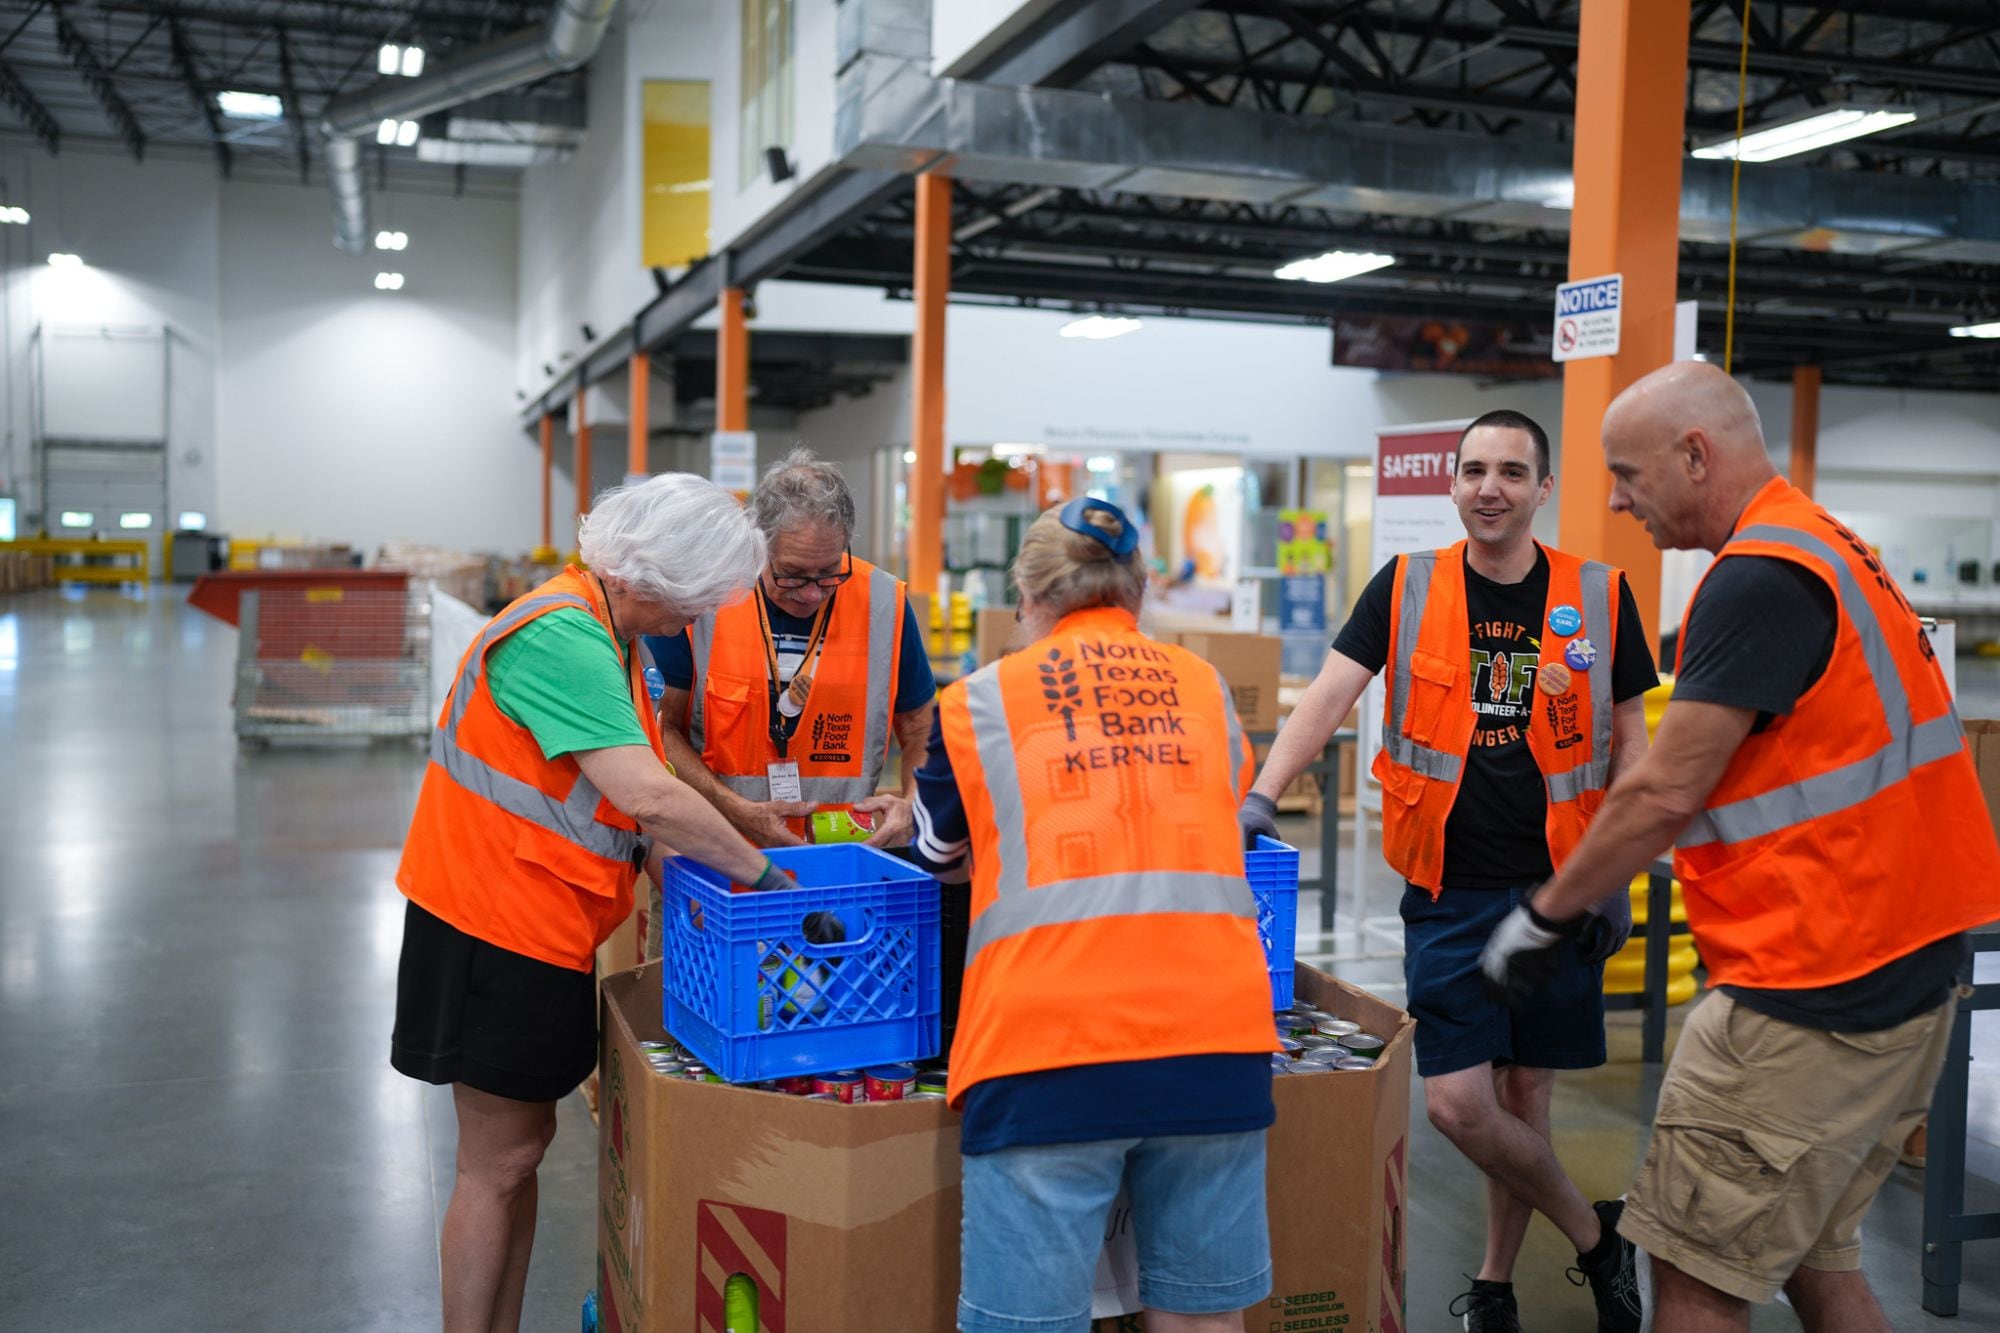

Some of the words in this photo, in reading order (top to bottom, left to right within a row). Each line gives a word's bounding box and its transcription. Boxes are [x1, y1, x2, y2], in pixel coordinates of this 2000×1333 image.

[1559, 282, 1618, 313] NOTICE
[1383, 452, 1443, 479] SAFETY
[1474, 621, 1527, 641] FIGHT
[1080, 641, 1171, 663] North
[1086, 663, 1178, 684] Texas
[1093, 685, 1180, 708] Food
[827, 713, 852, 722] North
[827, 722, 851, 731] Texas
[1100, 710, 1185, 737] Bank
[823, 741, 847, 750] Bank
[824, 732, 848, 741] Food
[1065, 743, 1190, 773] KERNEL
[1285, 1291, 1336, 1306] SEEDED
[1284, 1302, 1344, 1316] WATERMELON
[1284, 1314, 1350, 1331] SEEDLESS
